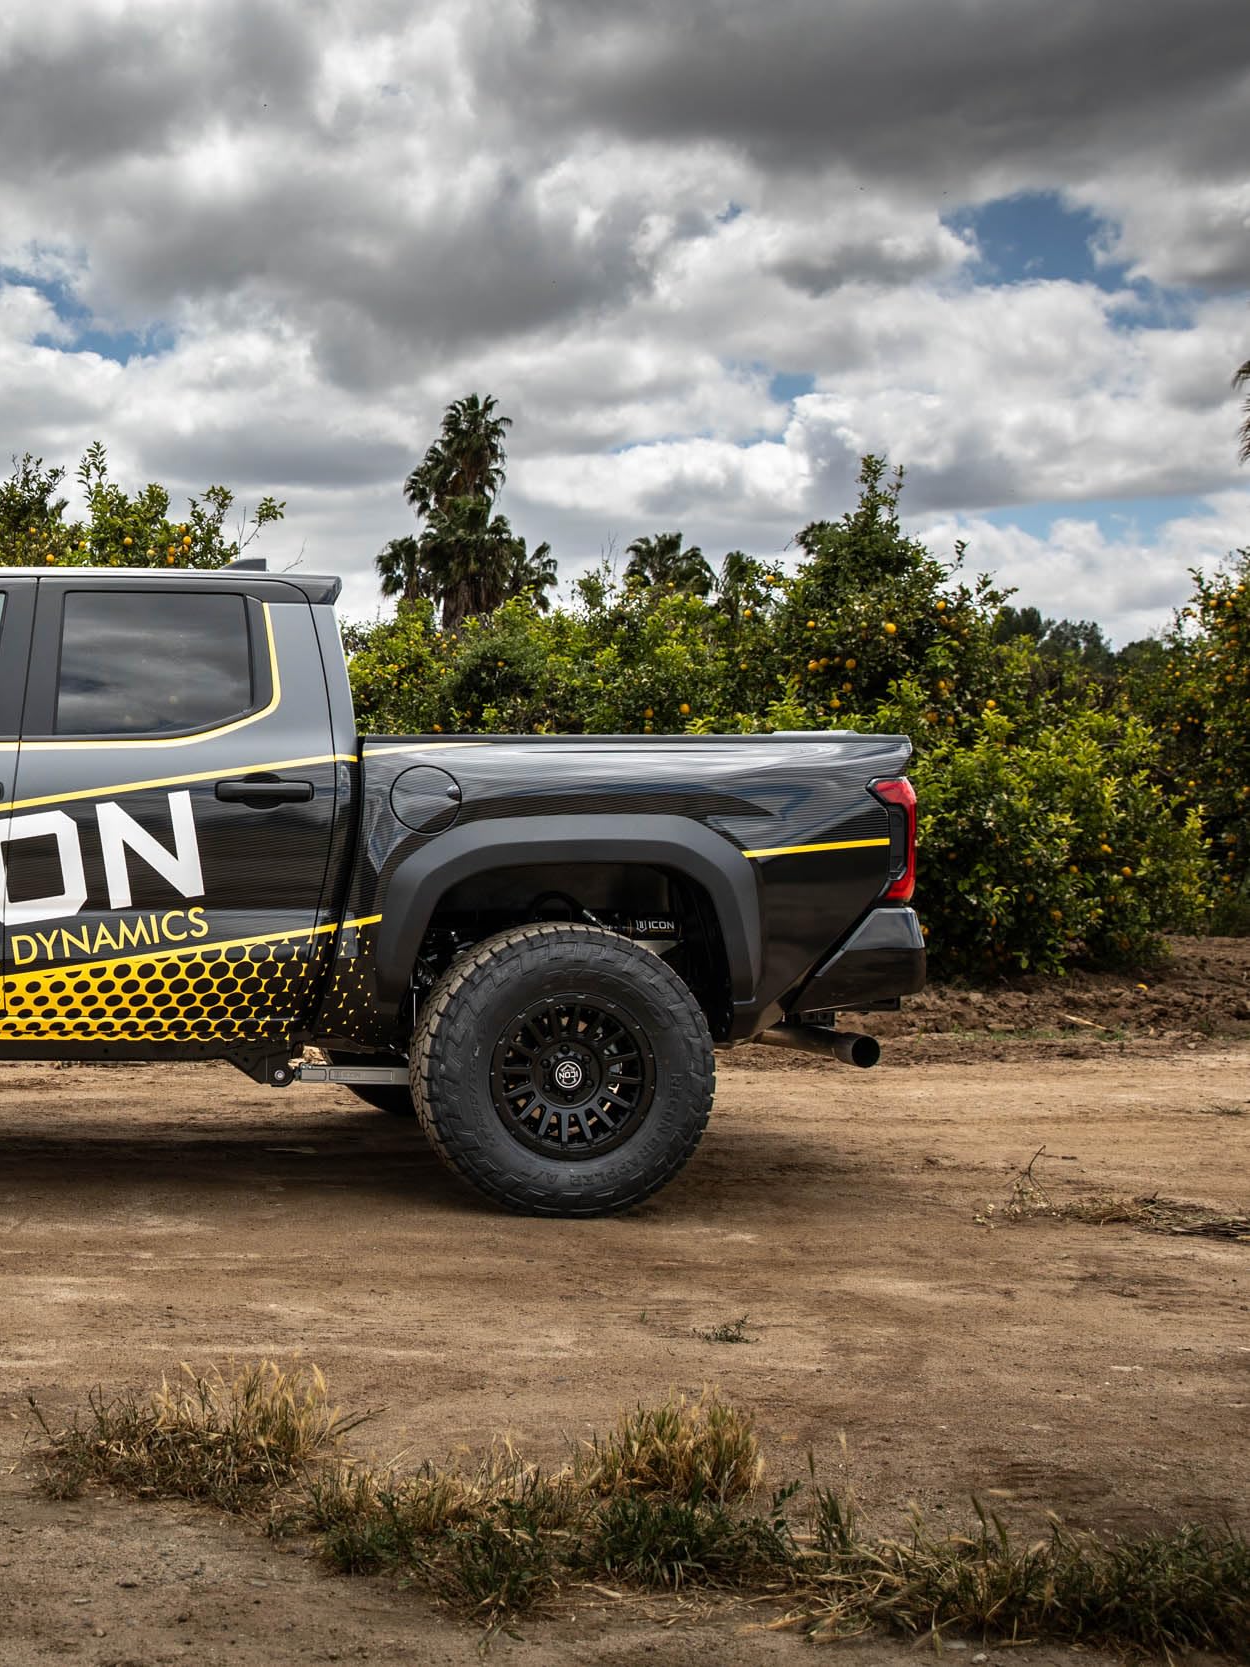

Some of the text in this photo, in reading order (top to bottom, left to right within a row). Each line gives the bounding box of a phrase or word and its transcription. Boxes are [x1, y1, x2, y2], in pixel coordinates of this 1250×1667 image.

[648, 920, 675, 929] ICON
[11, 906, 209, 966] DYNAMICS
[558, 1070, 579, 1080] ICON
